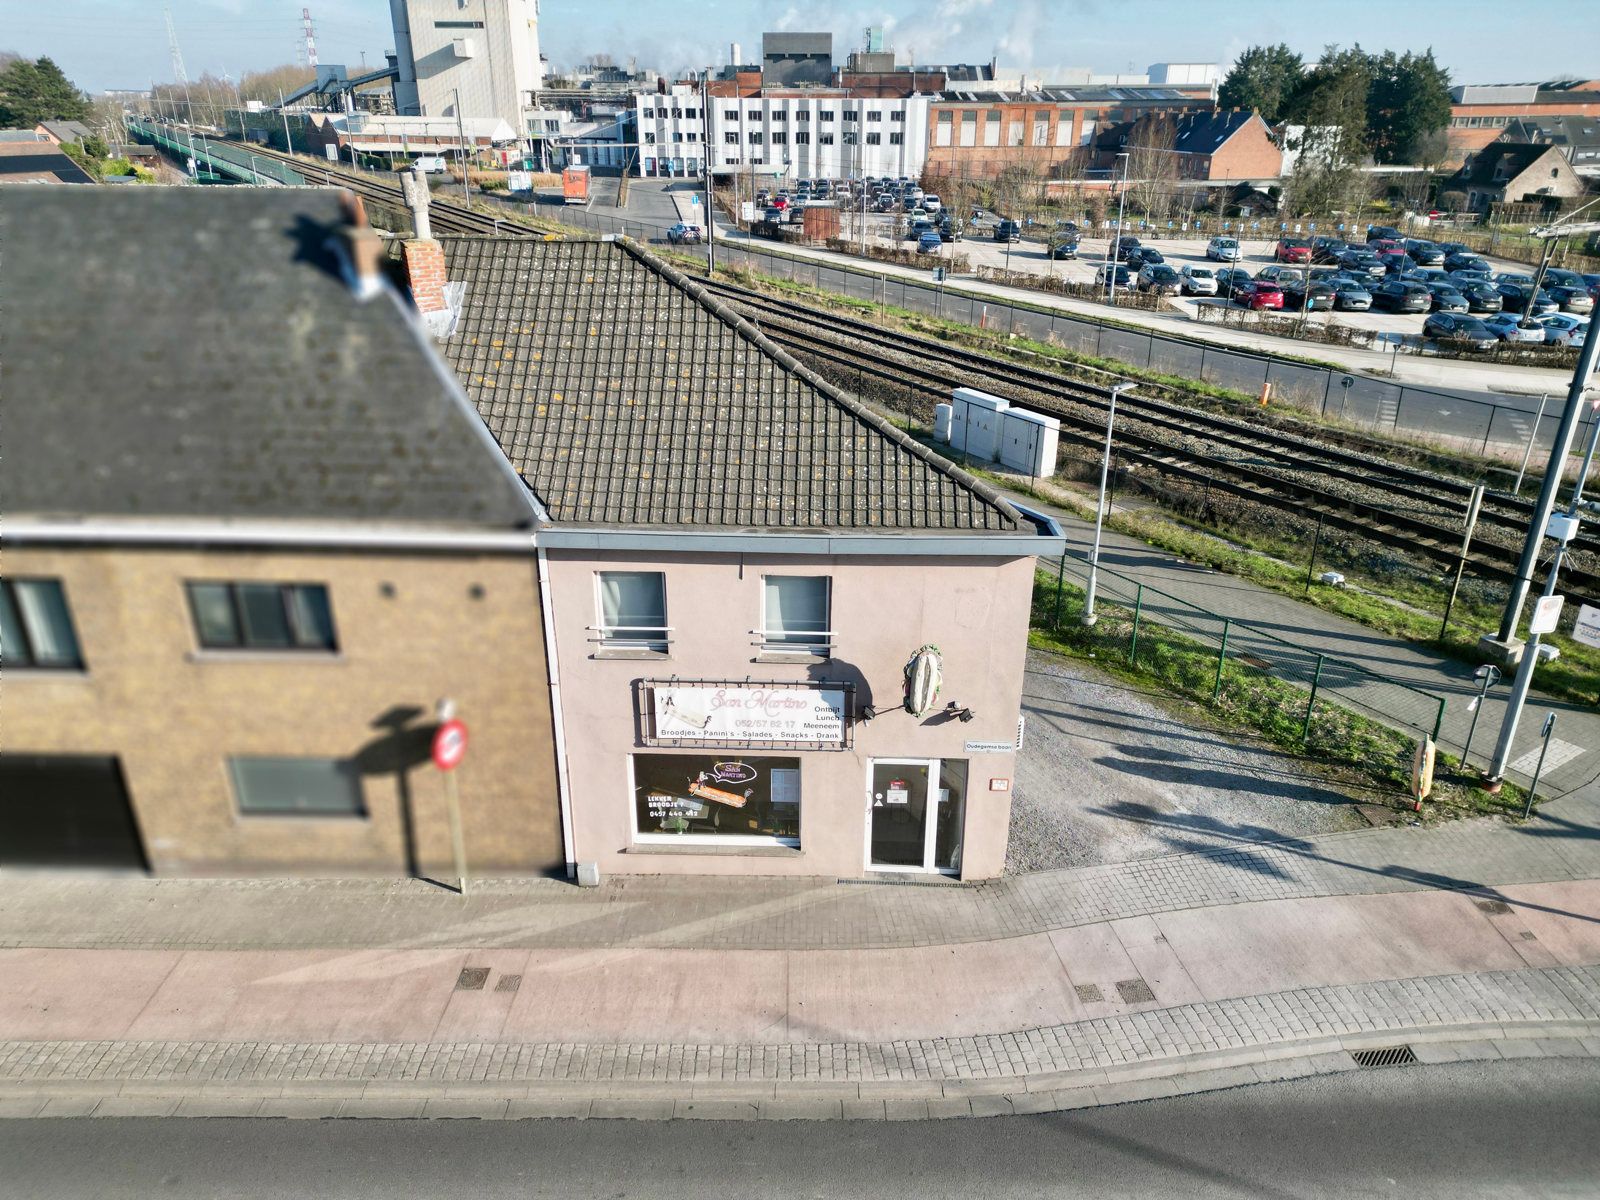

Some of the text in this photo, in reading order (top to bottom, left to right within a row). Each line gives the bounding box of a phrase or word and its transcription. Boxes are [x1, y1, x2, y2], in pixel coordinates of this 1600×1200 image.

[711, 689, 808, 718] San Martino
[814, 705, 840, 715] Ontbijt
[816, 714, 840, 722] Lunch
[785, 720, 796, 729] 17
[803, 722, 840, 730] Meeneem
[661, 729, 696, 738] Broodjes
[703, 730, 735, 738] Panini's
[742, 731, 773, 739] Salades
[780, 732, 809, 740] Snacks
[816, 732, 839, 740] Drank
